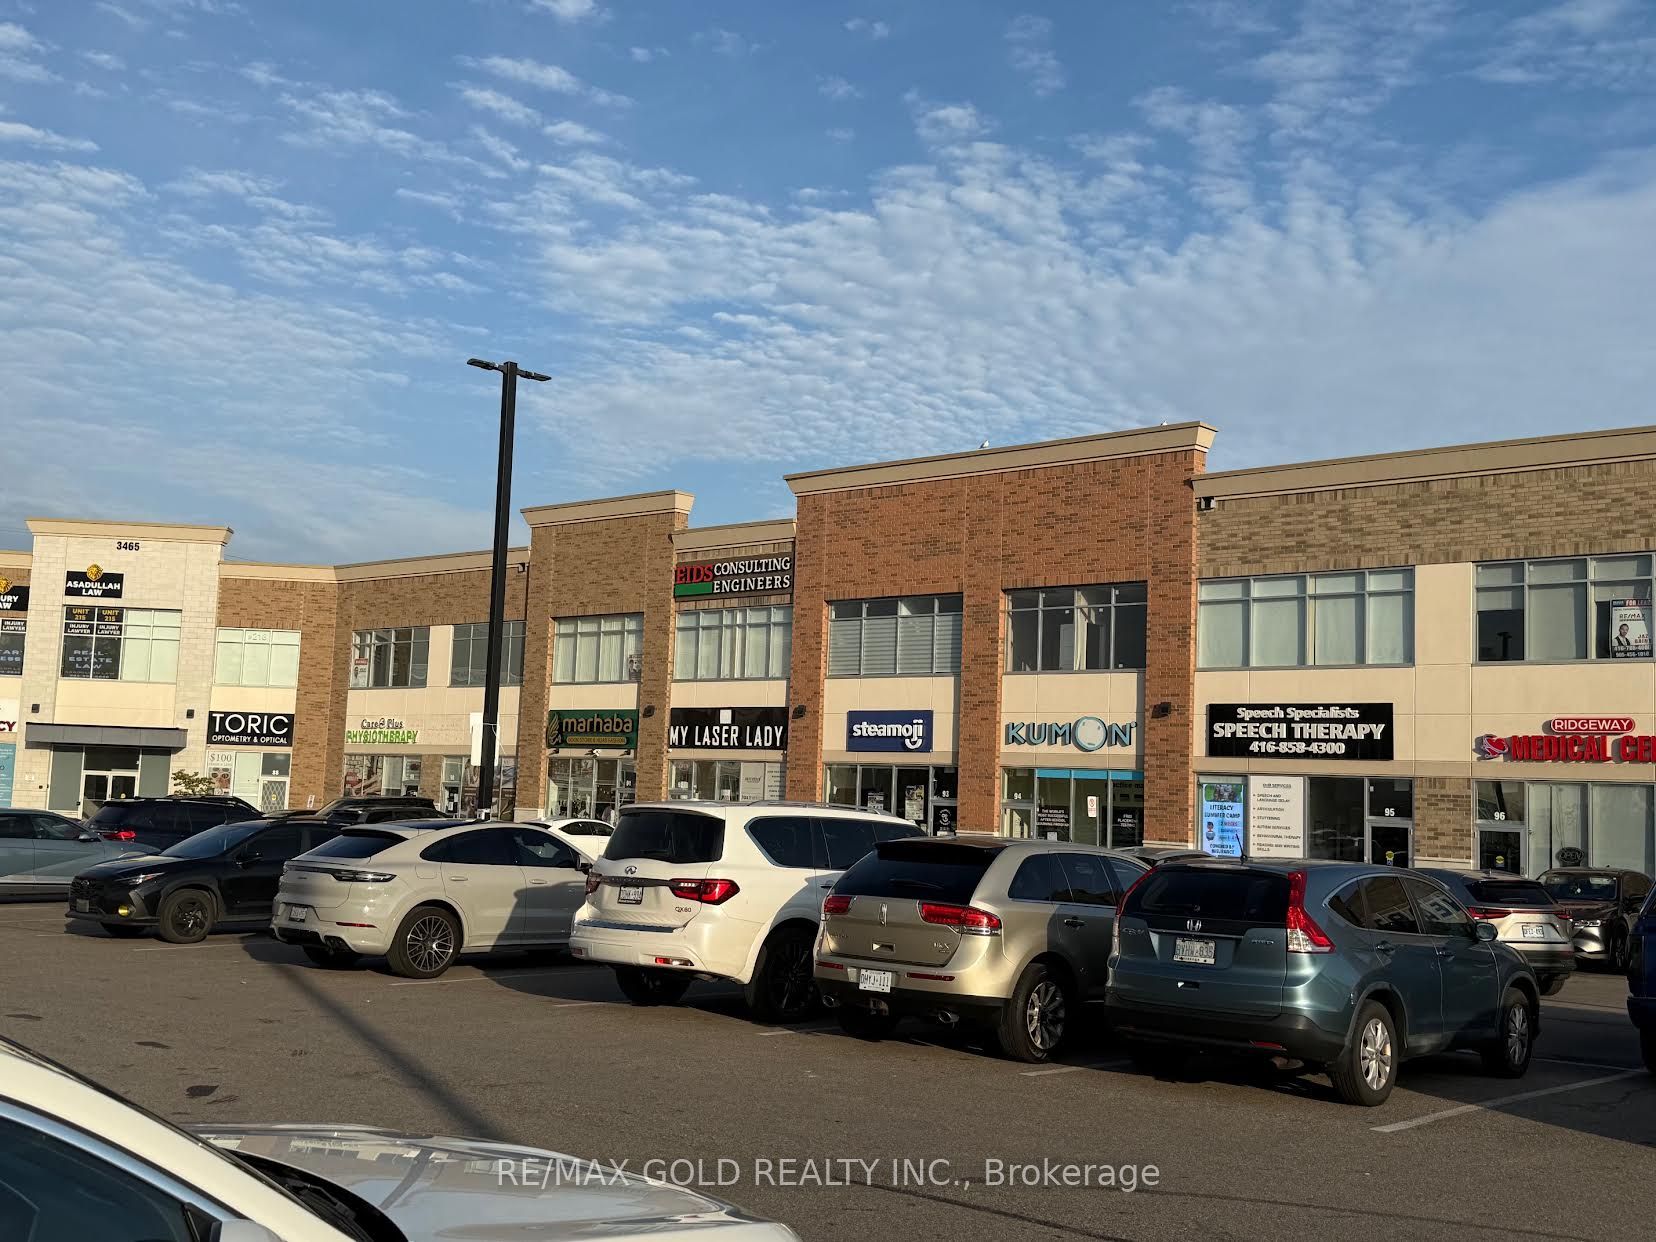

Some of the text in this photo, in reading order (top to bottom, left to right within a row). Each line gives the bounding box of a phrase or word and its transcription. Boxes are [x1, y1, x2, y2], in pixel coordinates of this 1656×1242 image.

[116, 541, 140, 551] 3465
[714, 557, 790, 576] CONSULTING
[66, 581, 121, 590] ASADULLAH
[713, 575, 790, 593] ENGINEERS
[1237, 706, 1360, 721] Speech Specialists
[212, 714, 289, 734] TORIC
[361, 718, 404, 729] Care Plus
[562, 713, 633, 733] marhaba
[1555, 719, 1630, 731] RIDGEWAY
[345, 730, 418, 744] PHYSIOTHERAPY
[669, 725, 784, 747] MY LASER LADY
[852, 719, 924, 750] steamoji
[1006, 716, 1137, 751] KUMON
[1213, 722, 1386, 740] SPEECH THERAPY
[212, 734, 252, 743] OPTOMETRY
[260, 736, 287, 744] OPTICAL
[1249, 741, 1346, 754] 416-858-4300
[1512, 735, 1613, 762] MEDICAL
[210, 753, 232, 763] $100
[942, 790, 950, 798] 93
[1013, 792, 1022, 800] 94
[1384, 808, 1395, 817] 95
[1494, 811, 1506, 820] 96
